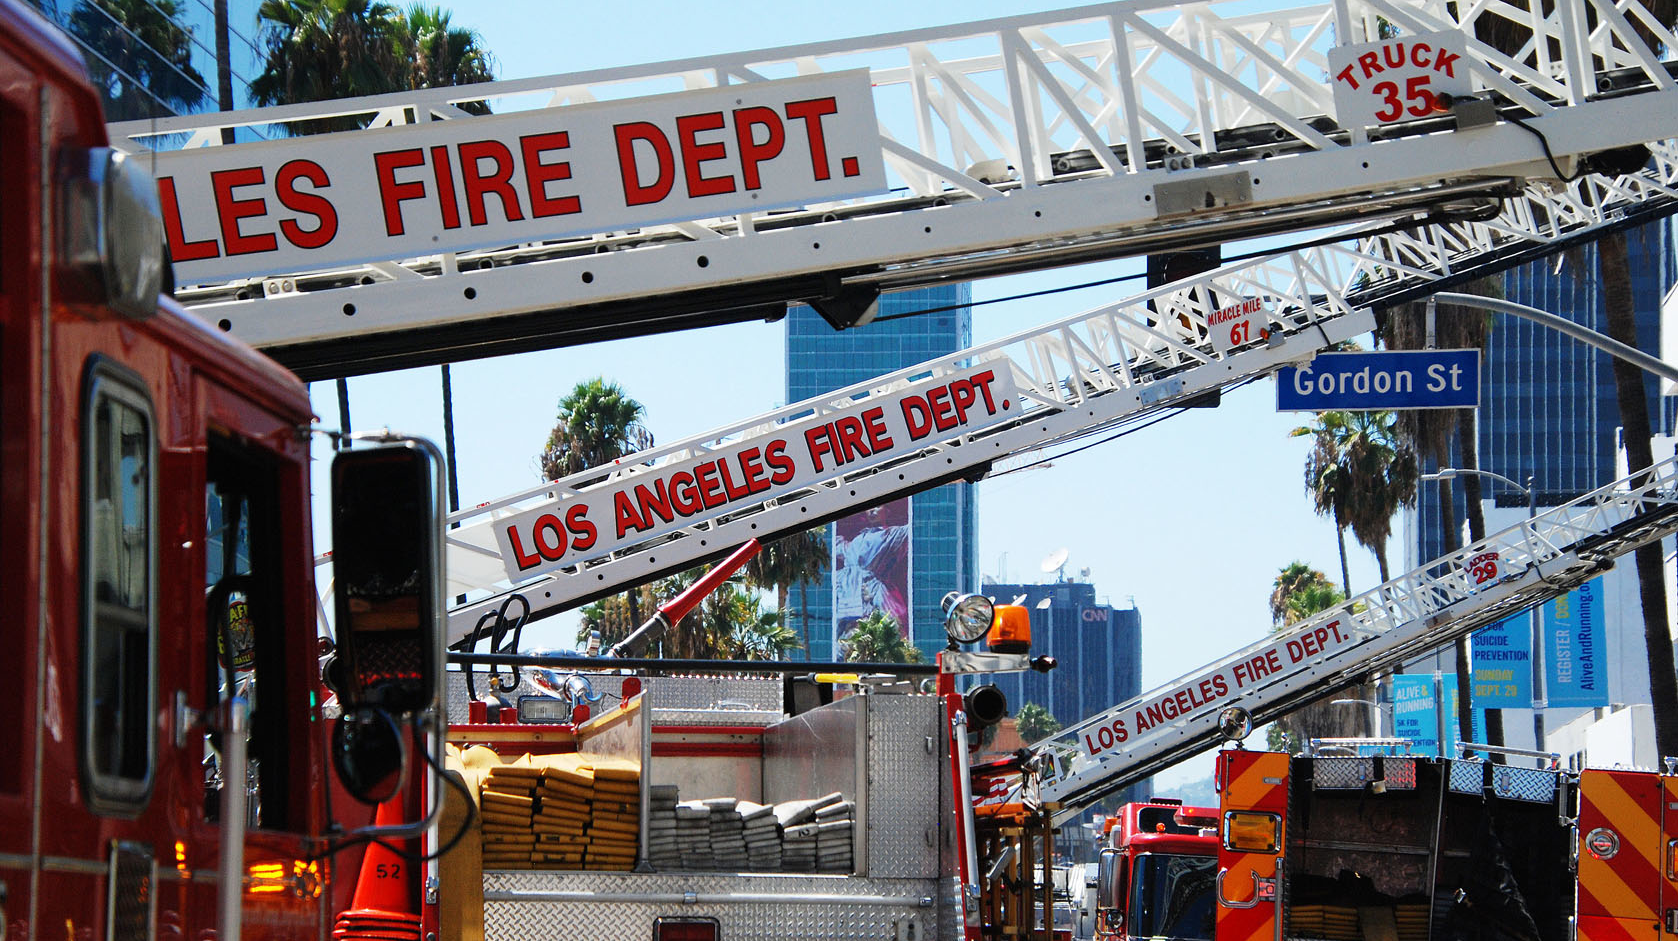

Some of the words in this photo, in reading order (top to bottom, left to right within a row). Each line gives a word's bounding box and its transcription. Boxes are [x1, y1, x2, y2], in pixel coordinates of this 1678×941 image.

[1336, 42, 1462, 91] TRUCK
[1372, 74, 1436, 123] 35
[374, 130, 583, 237] FIRE
[613, 96, 861, 208] DEPT.
[1207, 304, 1242, 327] MIRACLE
[1242, 297, 1262, 315] MILE
[1230, 319, 1250, 346] 61
[1294, 365, 1413, 396] Gordon
[1426, 363, 1463, 392] St
[506, 503, 599, 571] LOS
[613, 438, 797, 540] ANGELES
[804, 405, 895, 474] FIRE
[899, 369, 1012, 442] DEPT.
[1464, 552, 1499, 574] LADDER
[1473, 561, 1498, 585] 29
[1082, 609, 1108, 622] CNN
[1555, 594, 1570, 619] DON
[1474, 635, 1509, 647] SUICIDE
[1474, 650, 1529, 661] PREVENTION
[1555, 629, 1572, 684] REGISTER
[1475, 669, 1514, 681] SUNDAY
[1085, 719, 1129, 756] LOS
[1135, 674, 1229, 735] ANGELES
[1232, 648, 1284, 689] FIRE
[1286, 619, 1350, 665] DEPT.
[1396, 686, 1420, 701] ALIVE
[1396, 697, 1434, 715] RUNNING
[1397, 729, 1421, 737] SUICIDE
[1406, 719, 1418, 727] FOR
[376, 863, 401, 879] 52
